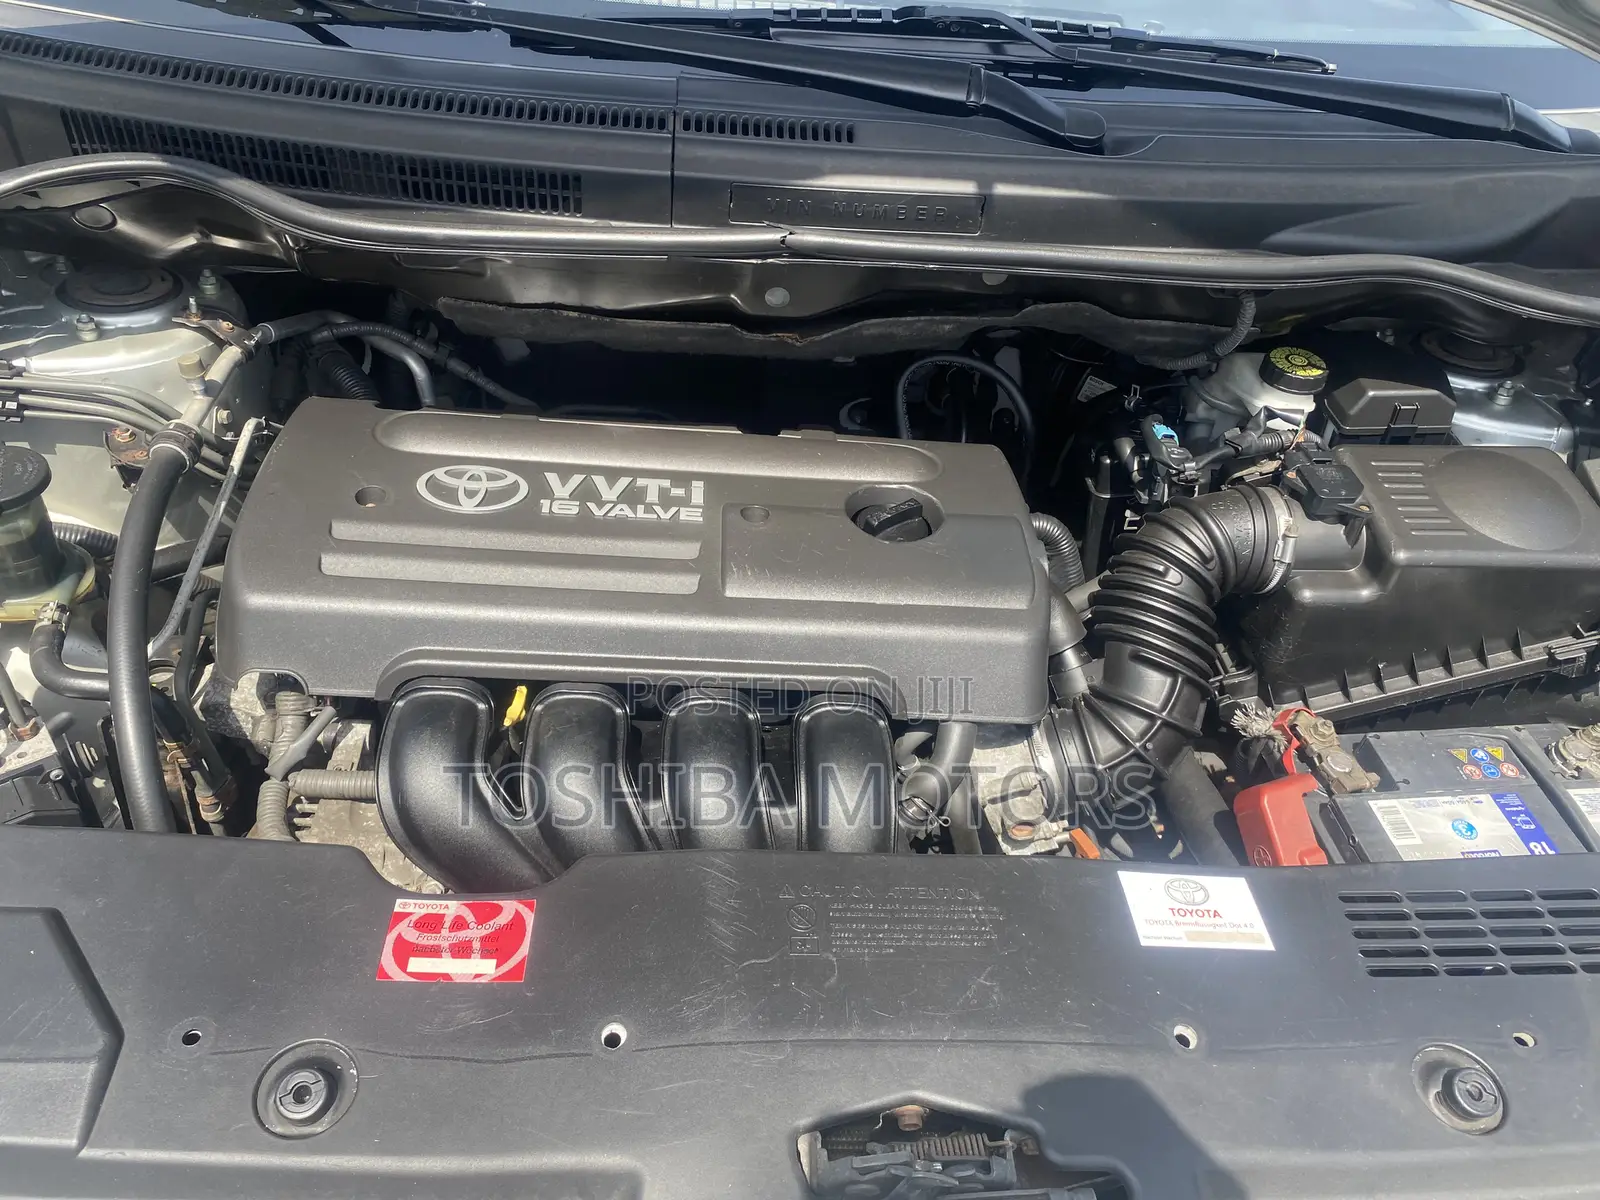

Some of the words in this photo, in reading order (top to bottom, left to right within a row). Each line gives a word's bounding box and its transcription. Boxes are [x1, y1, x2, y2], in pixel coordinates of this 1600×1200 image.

[767, 196, 812, 216] VIN
[832, 200, 949, 223] NUMBER
[543, 471, 705, 506] VVT-i
[539, 498, 581, 515] 16
[585, 501, 705, 523] VALVE
[799, 884, 876, 898] CAUTION
[885, 886, 981, 900] ATTENTION
[411, 902, 450, 911] TOYOTA
[1168, 907, 1223, 919] TOYOTA
[407, 919, 437, 932] Long
[441, 920, 464, 931] Life
[467, 921, 515, 932] Coolant
[1144, 918, 1174, 927] TOYOTA
[416, 932, 500, 943] Frostschutzmittel
